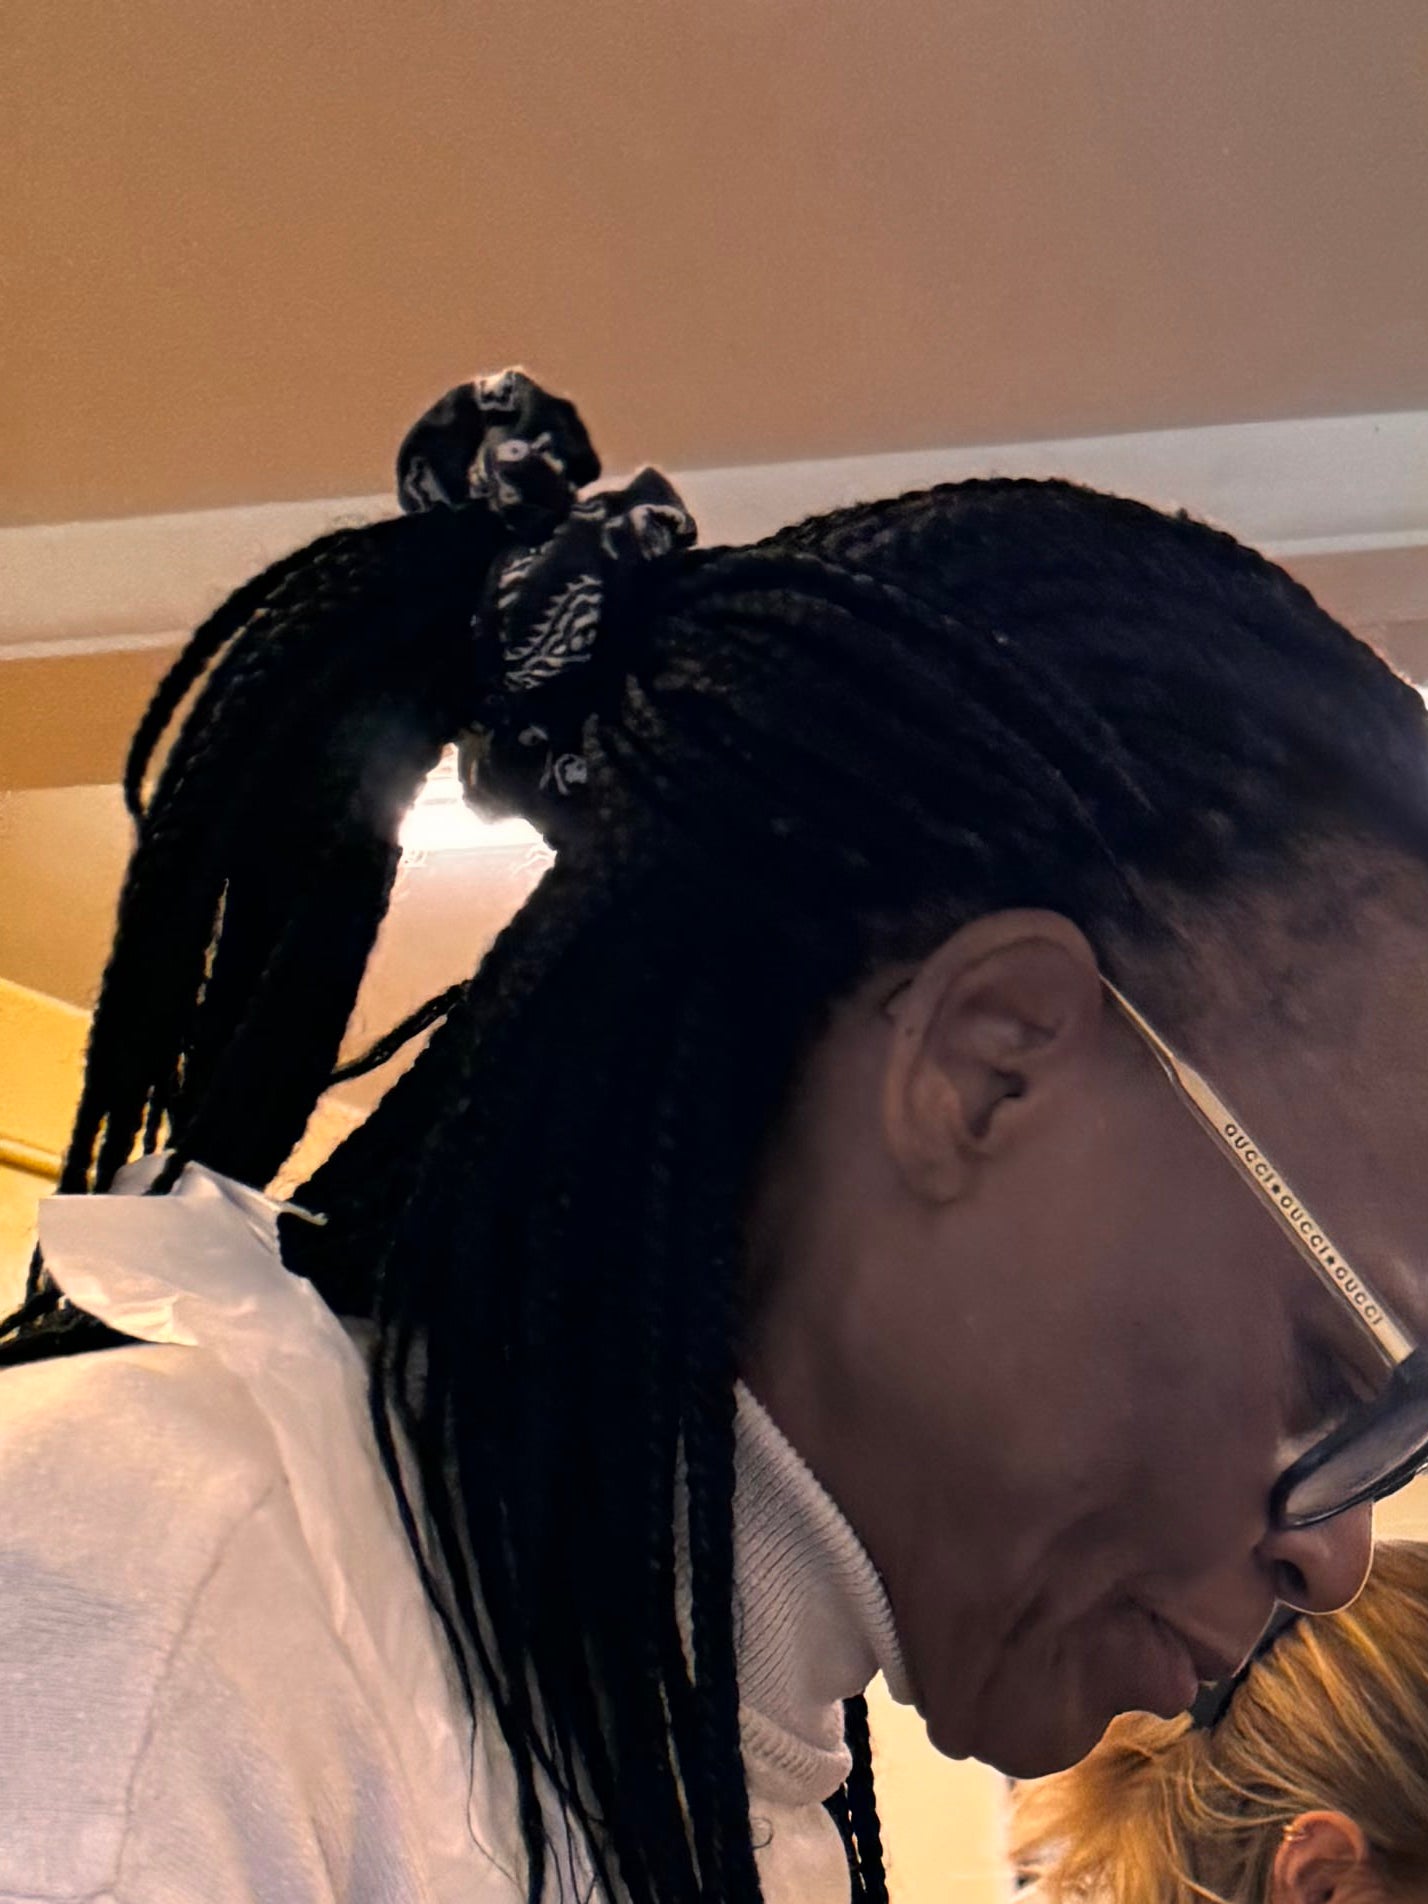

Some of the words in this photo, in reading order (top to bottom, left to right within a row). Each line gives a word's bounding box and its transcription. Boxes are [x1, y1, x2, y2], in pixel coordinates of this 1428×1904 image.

[1225, 1123, 1275, 1183] GUCCI
[1280, 1195, 1330, 1254] GUCCI
[1335, 1266, 1384, 1326] GUCCI
